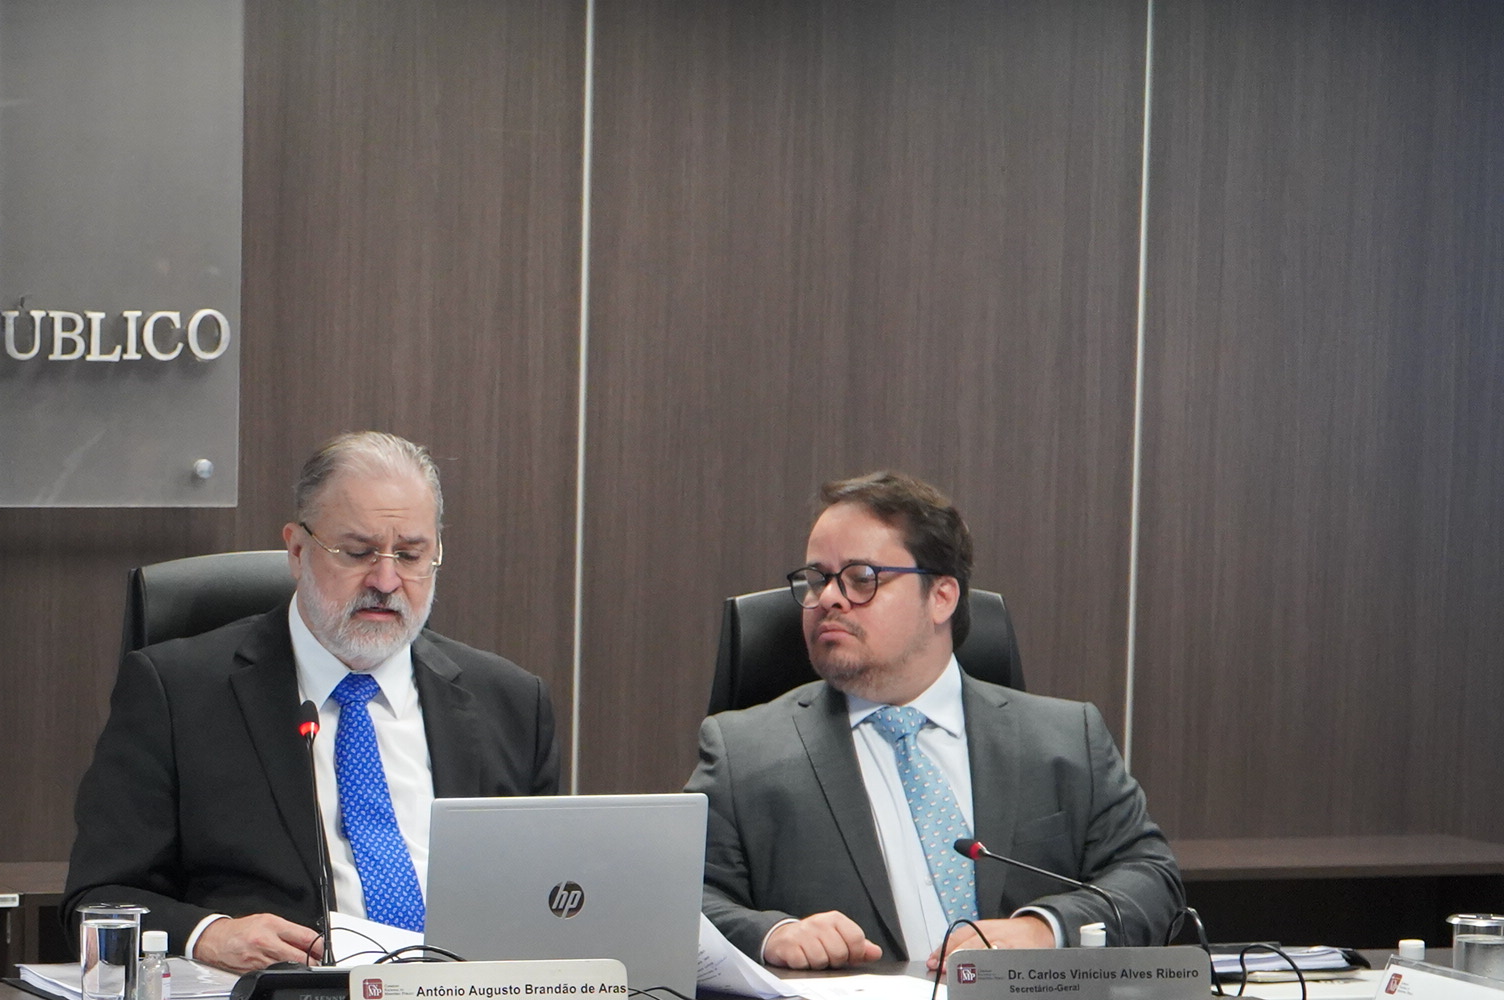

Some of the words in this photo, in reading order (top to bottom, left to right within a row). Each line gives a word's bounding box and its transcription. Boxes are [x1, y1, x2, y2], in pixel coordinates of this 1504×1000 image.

[551, 881, 583, 918] hp
[1008, 969, 1025, 980] Dr.
[1028, 969, 1066, 980] Carlos
[1070, 969, 1117, 980] Vinícius
[1120, 968, 1153, 979] Alves
[1156, 968, 1199, 979] Ribeiro
[416, 985, 465, 997] Antônio
[469, 984, 521, 998] Augusto
[525, 983, 576, 995] Brandão
[580, 983, 596, 994] de
[599, 983, 627, 994] Aras
[1009, 984, 1080, 993] Secretário-Geral
